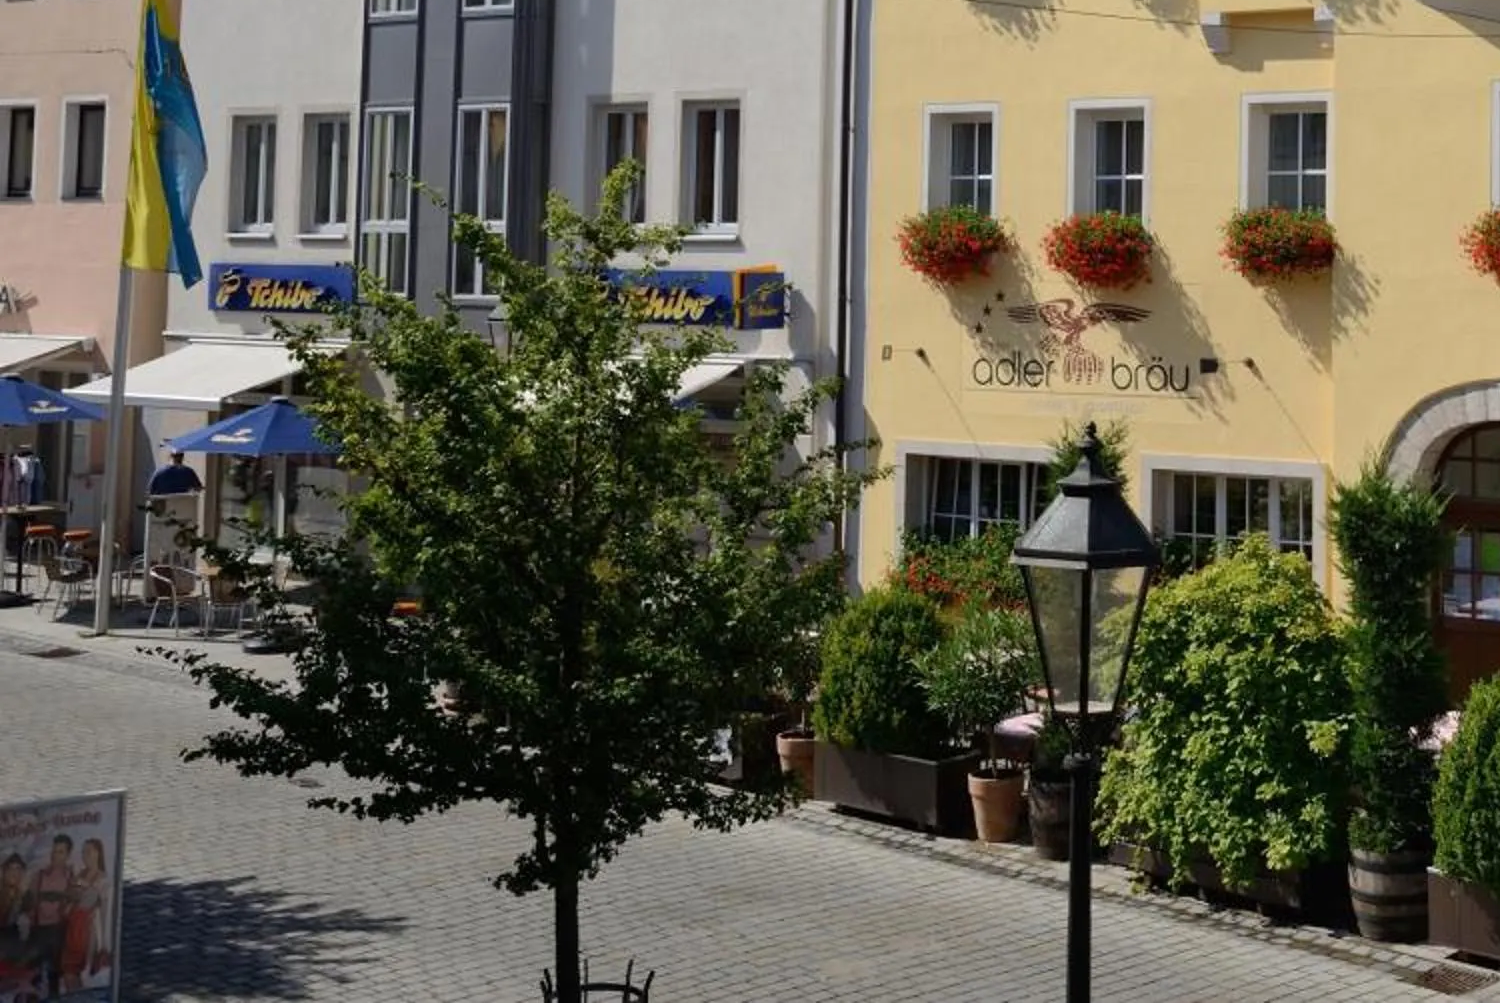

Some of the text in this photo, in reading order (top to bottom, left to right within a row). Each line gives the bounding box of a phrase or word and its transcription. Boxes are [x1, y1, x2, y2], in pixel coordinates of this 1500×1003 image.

[247, 277, 324, 309] Tchibo
[972, 351, 1190, 392] adler bräu
